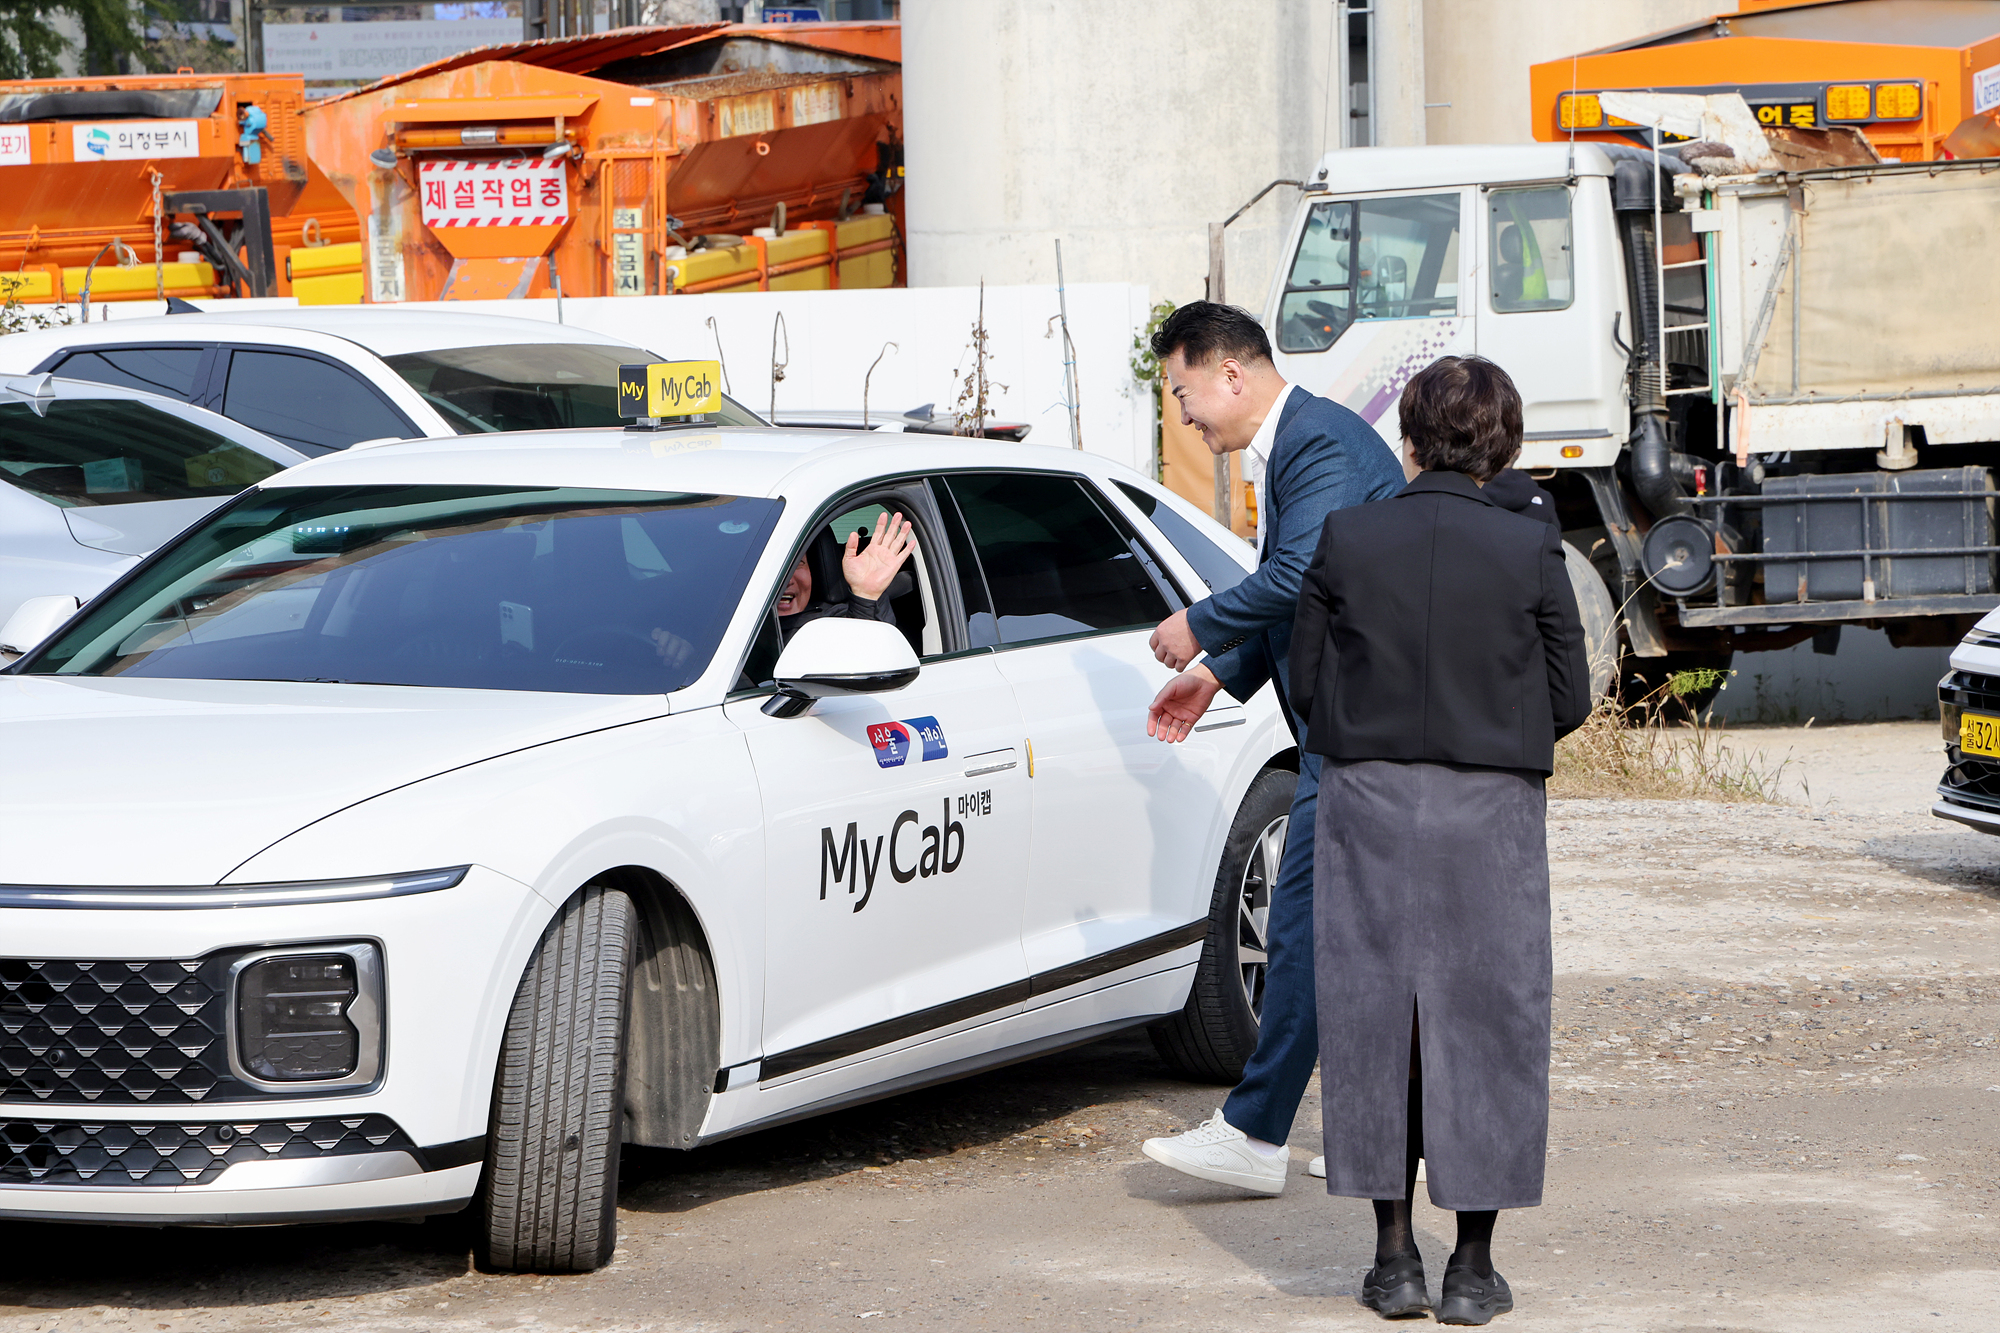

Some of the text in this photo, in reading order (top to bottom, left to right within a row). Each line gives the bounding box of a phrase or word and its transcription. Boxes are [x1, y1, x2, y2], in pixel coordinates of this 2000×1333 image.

[119, 131, 187, 150] 의정부시
[425, 178, 561, 210] 제설작업중
[622, 381, 645, 401] My
[873, 725, 946, 755] 서울 개인
[1966, 719, 1975, 749] 서울
[958, 789, 991, 819] 마이캡
